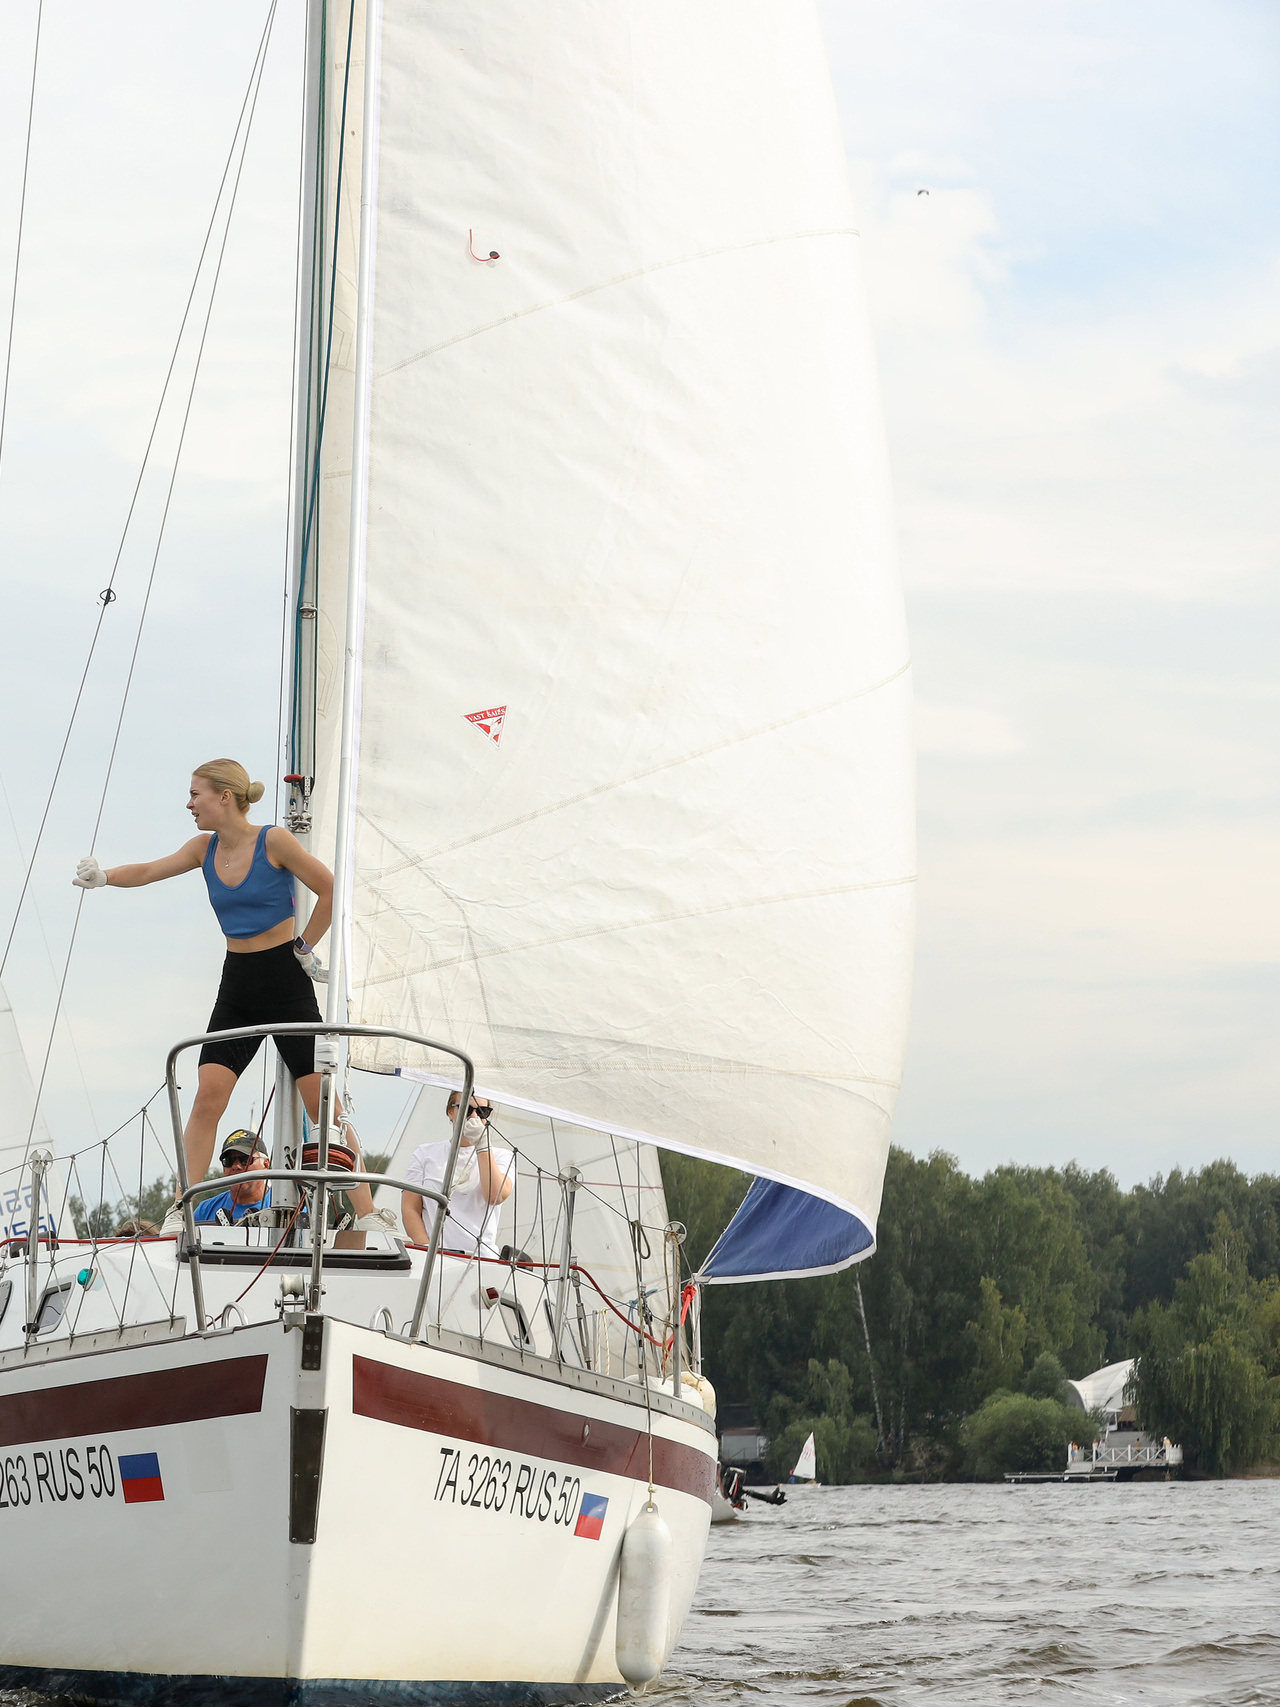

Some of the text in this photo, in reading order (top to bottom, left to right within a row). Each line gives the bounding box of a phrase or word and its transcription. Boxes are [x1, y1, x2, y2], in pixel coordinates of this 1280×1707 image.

[33, 1447, 85, 1503] RUS
[86, 1444, 115, 1498] 50
[434, 1447, 581, 1527] TA 3263 RUS 50
